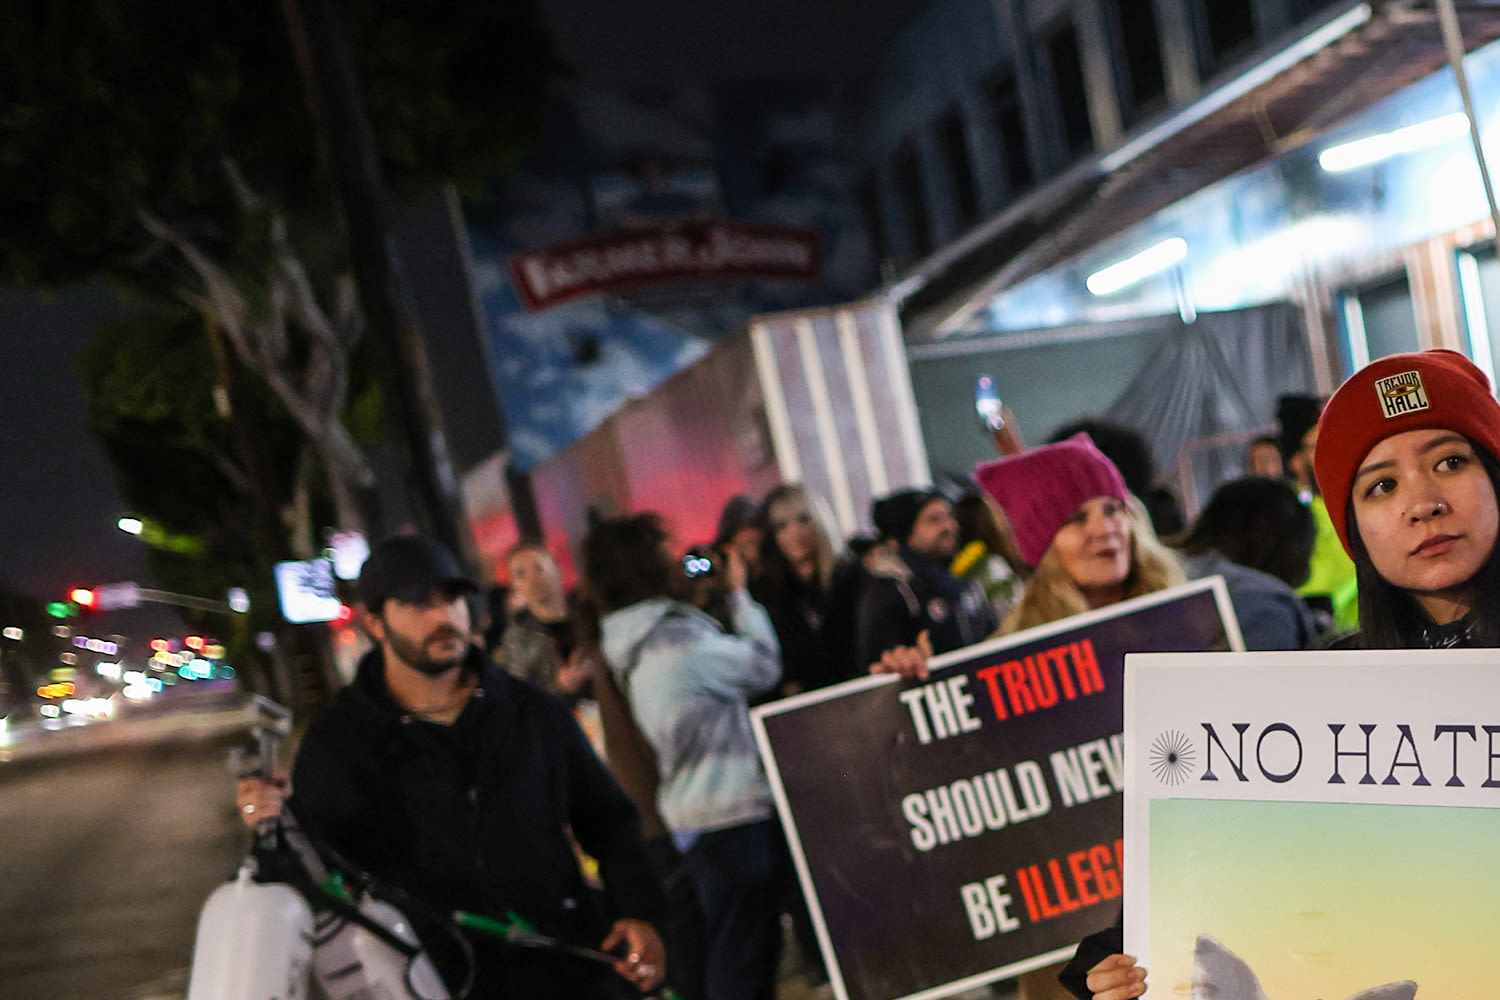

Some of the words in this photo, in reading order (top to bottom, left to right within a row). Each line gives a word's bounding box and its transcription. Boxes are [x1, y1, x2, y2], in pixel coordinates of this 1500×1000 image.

[1384, 389, 1428, 416] HALL
[900, 674, 982, 745] THE
[977, 638, 1105, 721] TRUTH
[902, 760, 1051, 851] SHOULD
[1050, 731, 1124, 808] NEV
[1200, 722, 1303, 783] NO
[960, 874, 1020, 941] BE
[1016, 840, 1124, 923] ILLEG
